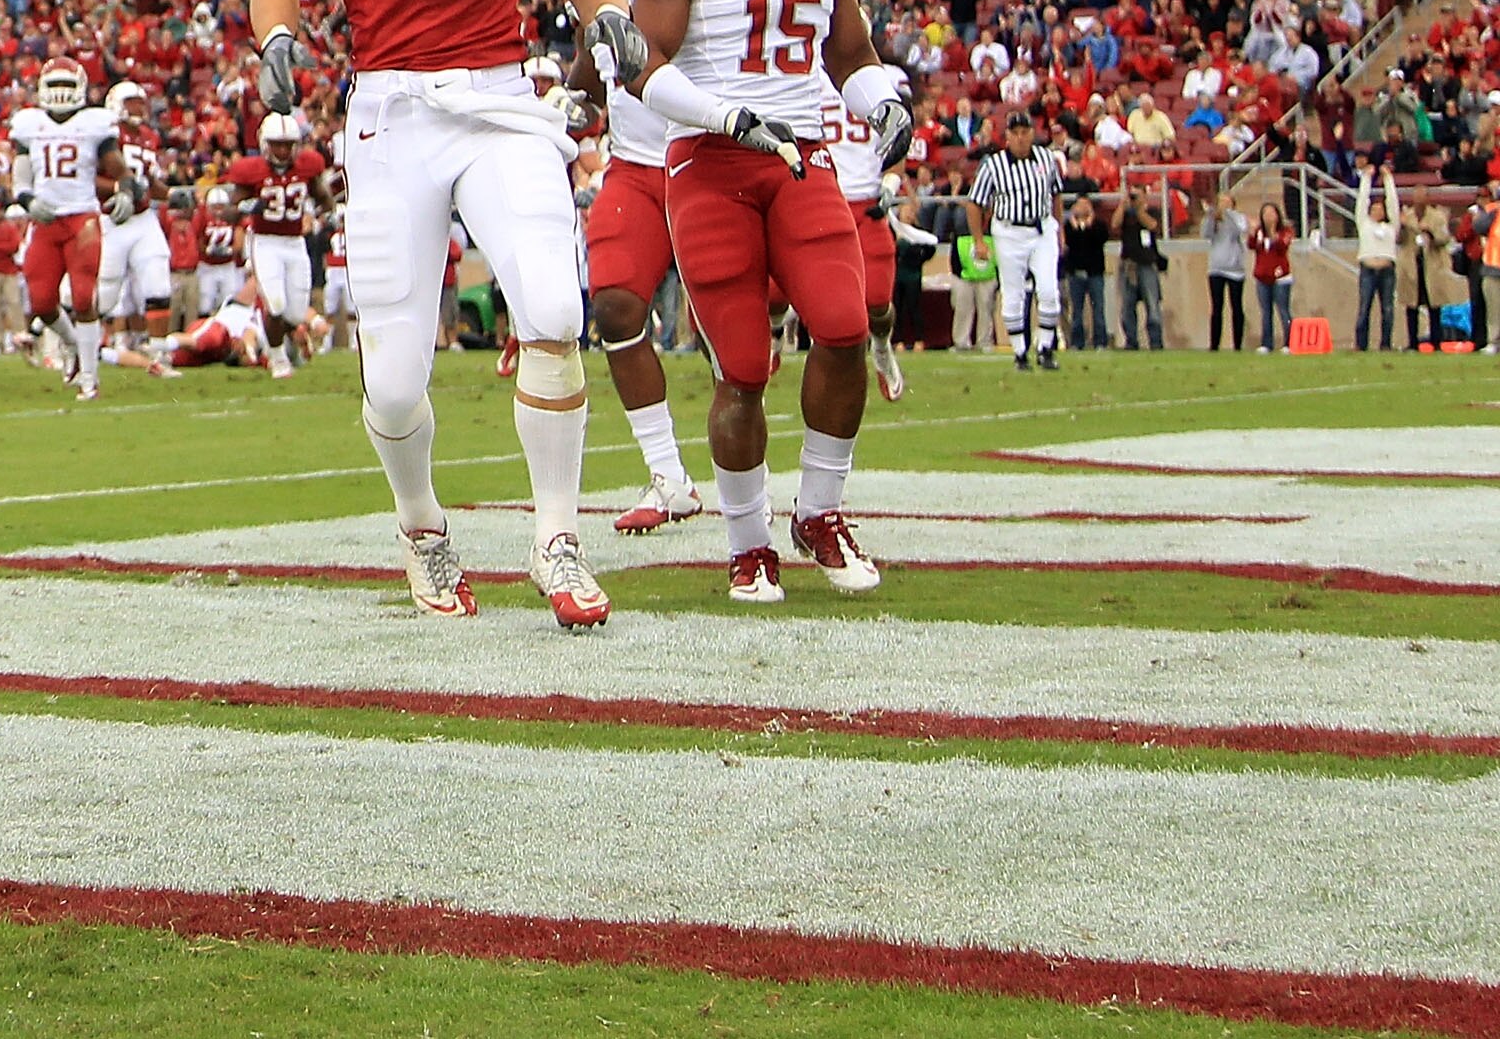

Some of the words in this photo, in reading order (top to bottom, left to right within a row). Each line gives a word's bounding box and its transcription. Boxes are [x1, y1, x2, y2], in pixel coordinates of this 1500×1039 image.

[43, 143, 78, 178] 12
[260, 181, 307, 221] 33
[1299, 324, 1319, 346] 10
